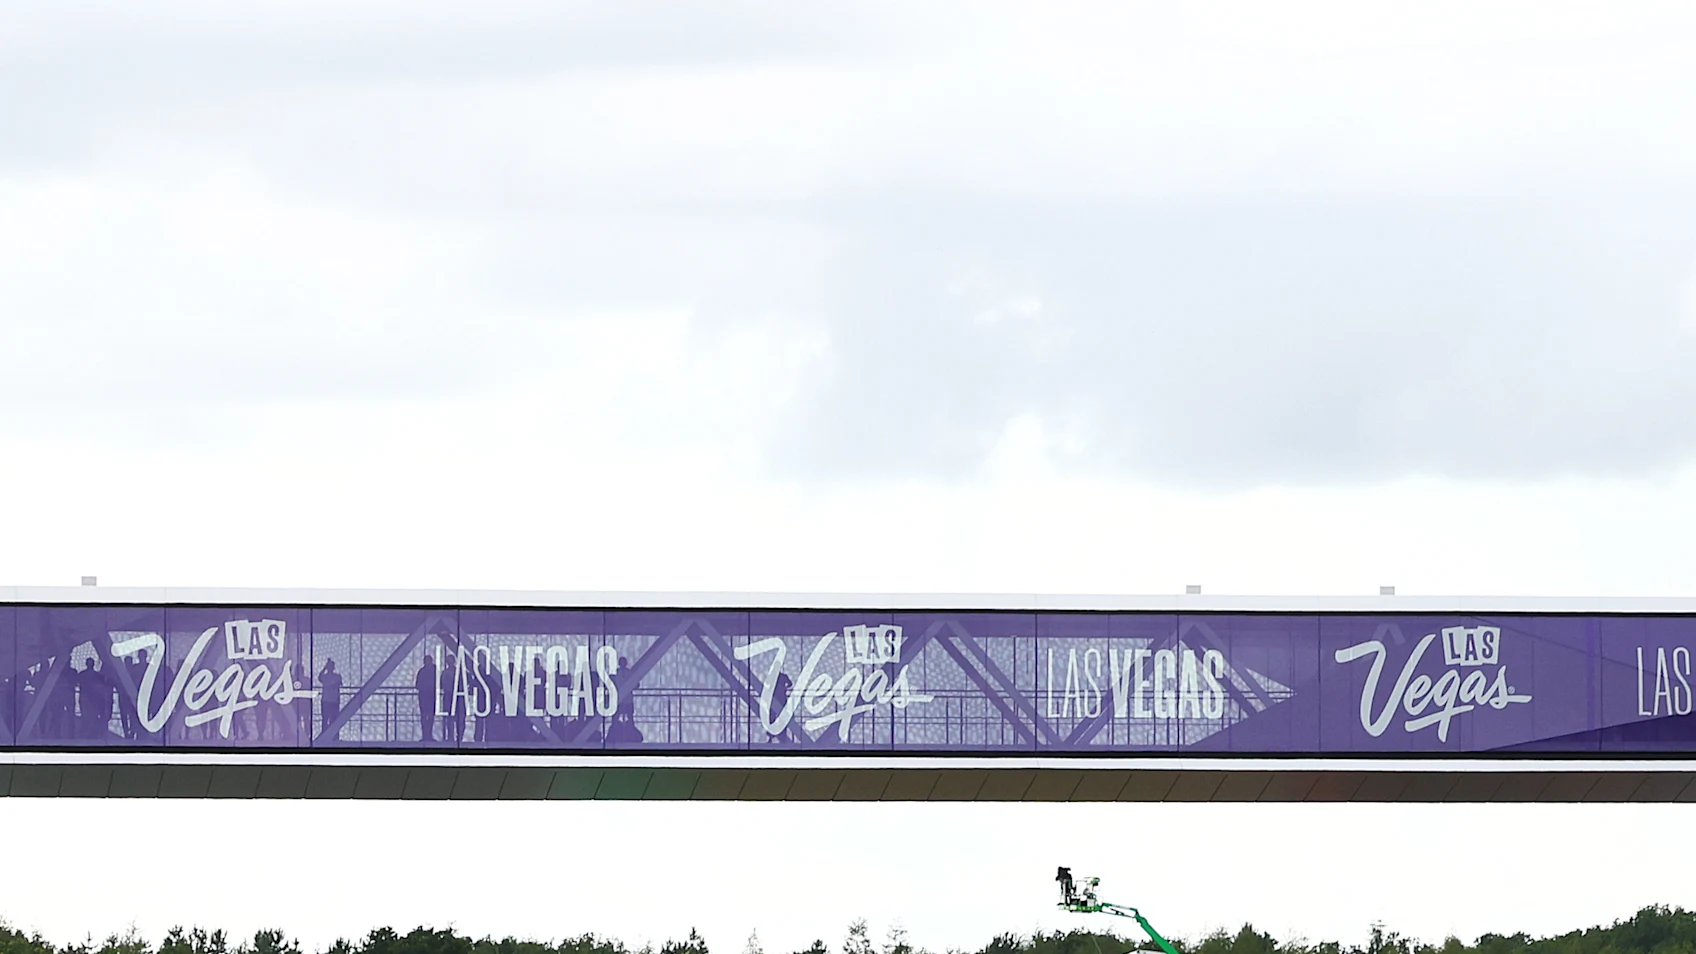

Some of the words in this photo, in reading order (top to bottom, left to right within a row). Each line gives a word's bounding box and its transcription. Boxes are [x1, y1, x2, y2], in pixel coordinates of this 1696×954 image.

[231, 624, 280, 655] LAS
[850, 629, 896, 660] LAS
[1448, 631, 1494, 661] LAS
[435, 645, 491, 717] LAS
[500, 645, 618, 717] VEGAS
[1047, 648, 1101, 718] LAS
[1109, 649, 1224, 719] VEGAS
[1637, 647, 1692, 715] LAS
